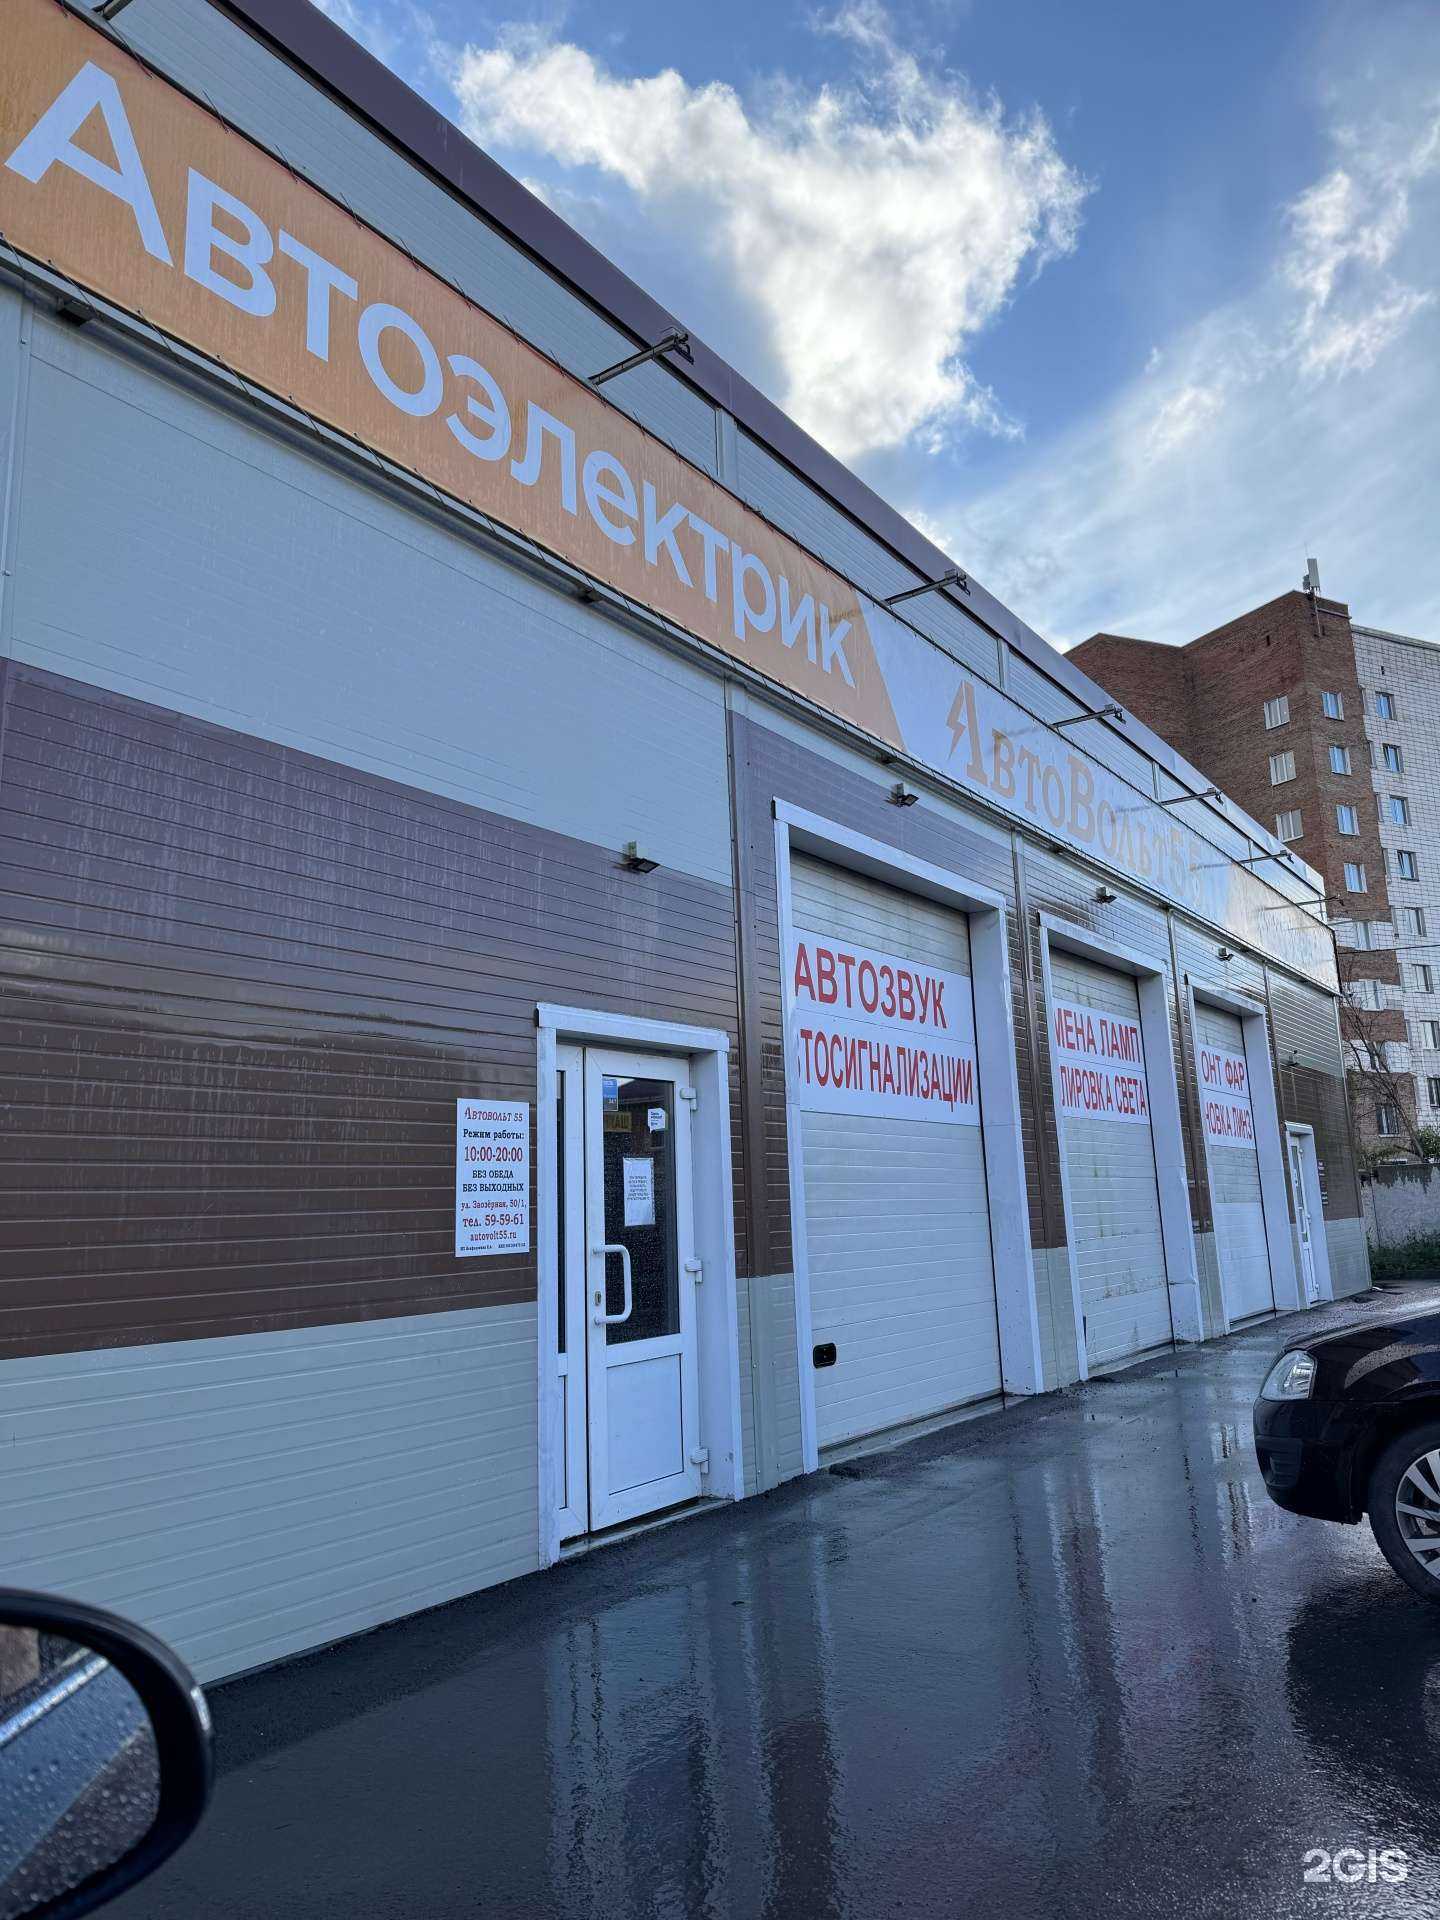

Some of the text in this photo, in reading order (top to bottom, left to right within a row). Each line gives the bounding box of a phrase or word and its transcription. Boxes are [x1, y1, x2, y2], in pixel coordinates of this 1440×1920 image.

[4, 60, 857, 690] Автоэлектрик
[794, 942, 948, 1029] АВТОЗВУК
[1099, 1018, 1141, 1064] ЛАМП
[798, 1028, 974, 1113] ТОСИГНАЛИЗАЦИИ
[1200, 1050, 1245, 1091] ОНТ ФАР
[1059, 1065, 1148, 1117] ЛИРОВКА СВЕТА
[463, 1128, 524, 1140] Режим работы:
[464, 1146, 523, 1162] 10:00-20:00
[462, 1183, 524, 1193] БЕЗ ВЫХОДНЫХ
[472, 1169, 514, 1180] БЕЗ ОБЕДА
[462, 1213, 525, 1228] тел. 59-59-61
[470, 1230, 517, 1242] autovolt55.ru
